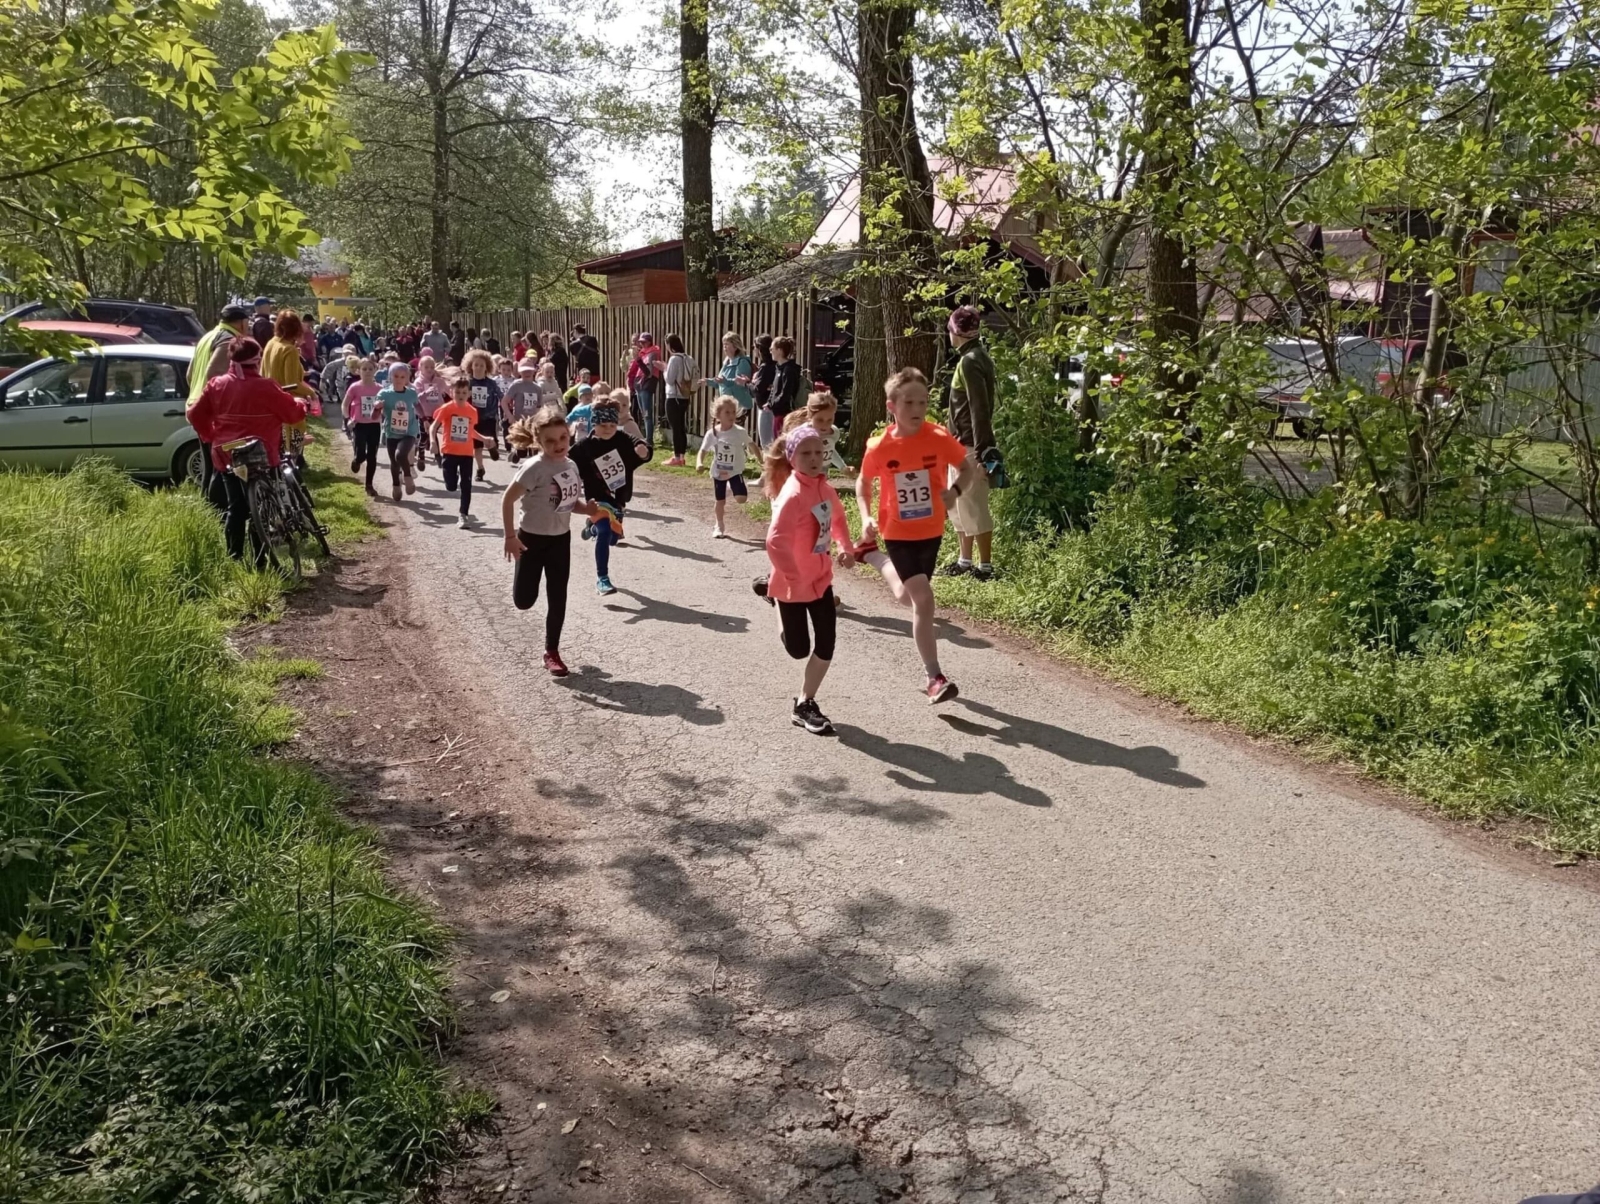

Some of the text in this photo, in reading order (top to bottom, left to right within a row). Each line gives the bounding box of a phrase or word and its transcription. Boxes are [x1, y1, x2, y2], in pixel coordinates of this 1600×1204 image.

[362, 403, 372, 411] 31
[391, 418, 408, 427] 316
[451, 425, 468, 435] 312
[717, 453, 734, 463] 311
[601, 460, 625, 480] 335
[562, 483, 578, 501] 343
[898, 486, 930, 504] 313
